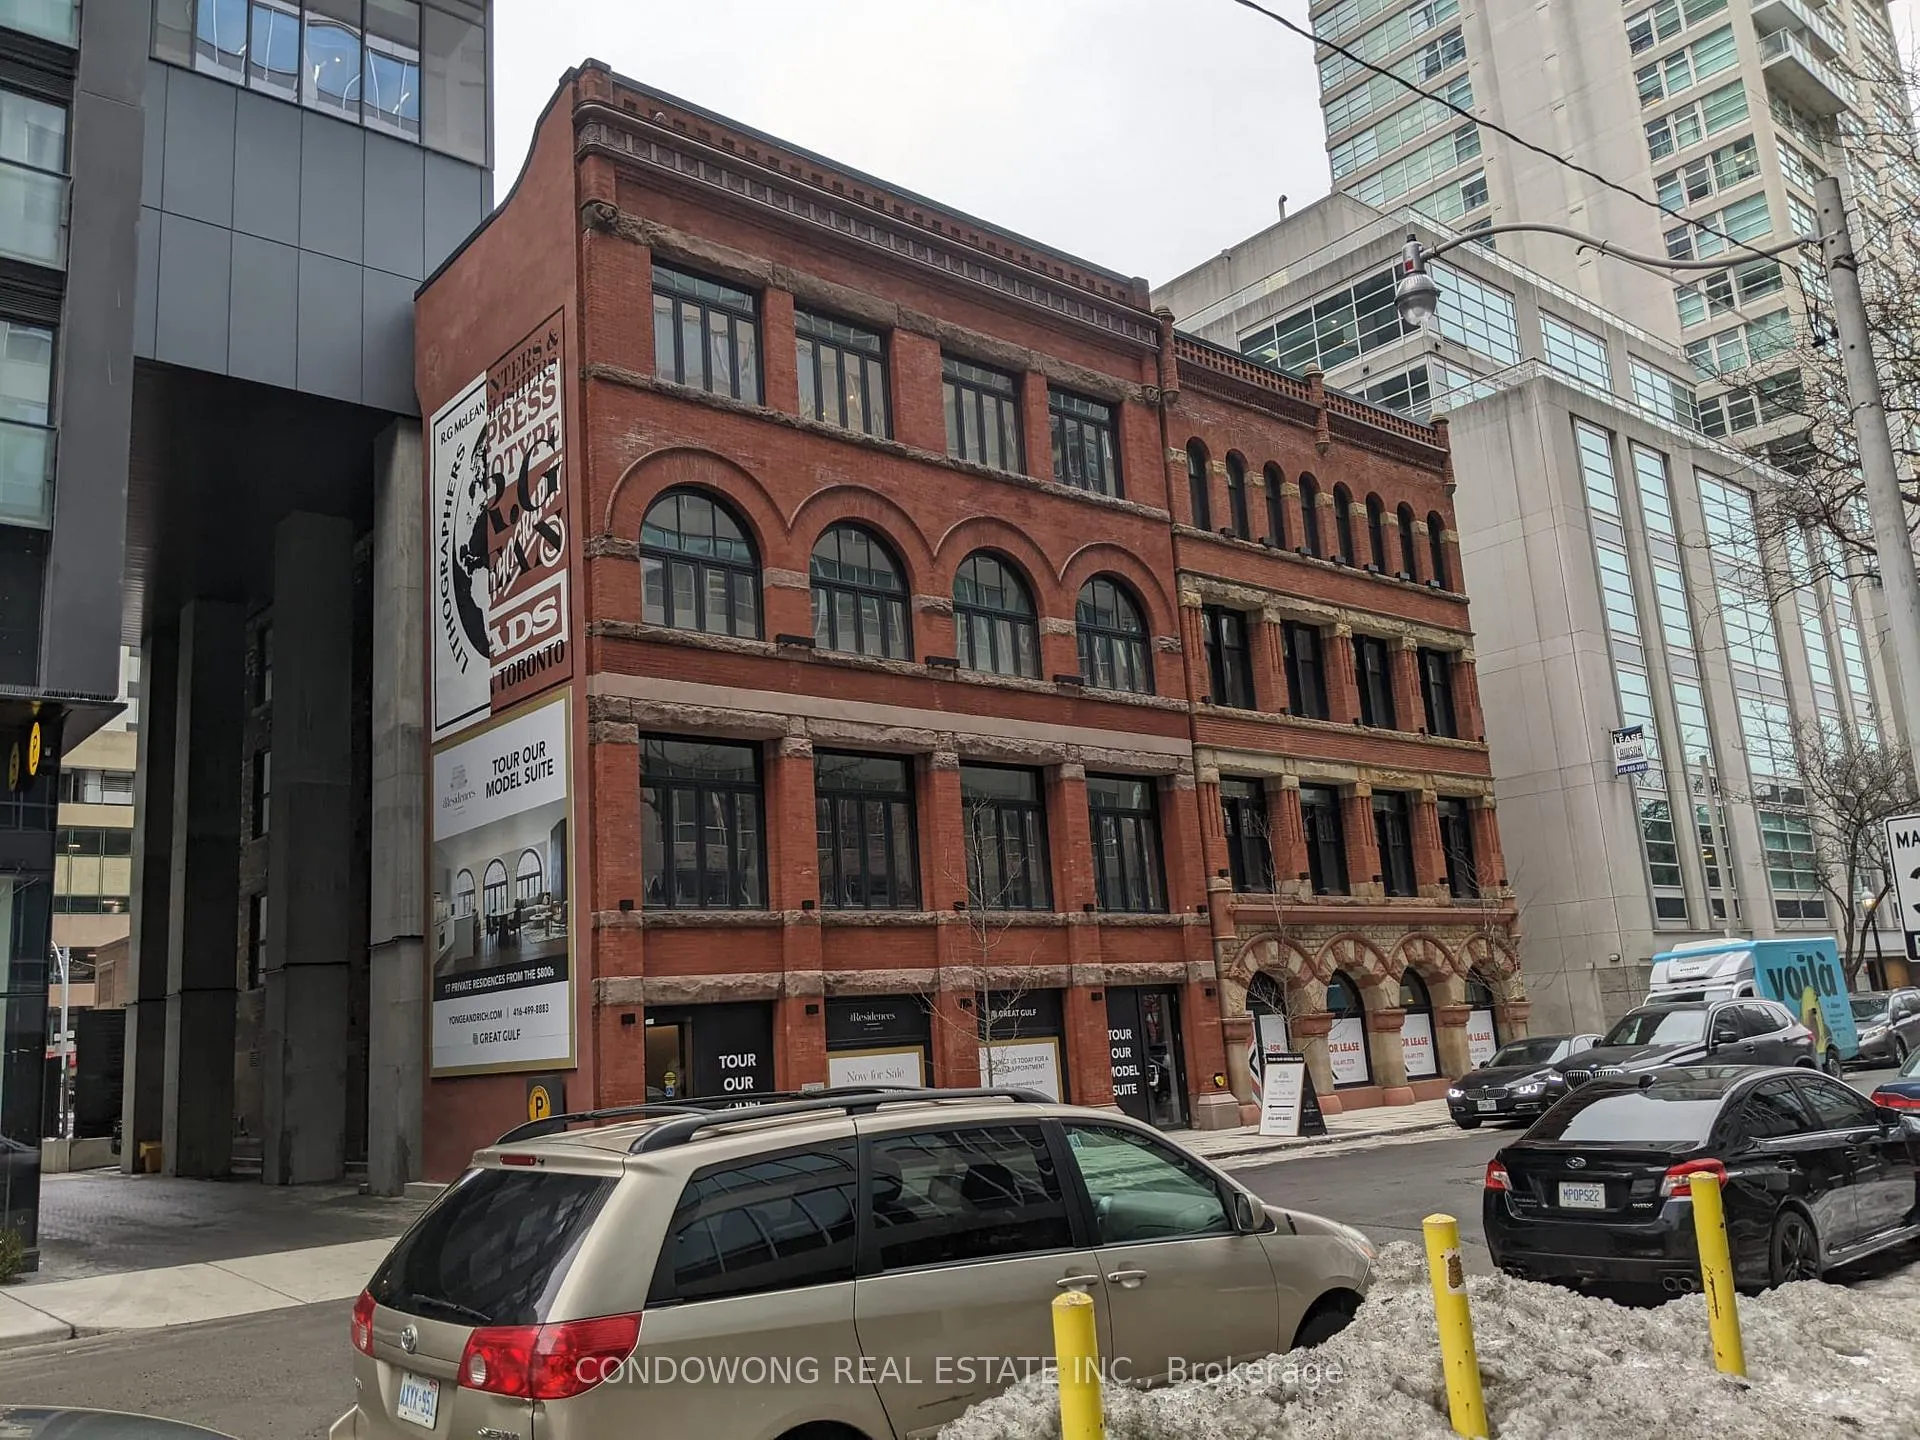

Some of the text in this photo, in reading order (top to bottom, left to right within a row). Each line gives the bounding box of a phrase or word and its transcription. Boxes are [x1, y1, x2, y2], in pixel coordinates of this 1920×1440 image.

[547, 328, 559, 351] &
[487, 373, 557, 454] PRESS
[487, 411, 560, 488] OTYPE
[440, 442, 469, 675] LITHOGRAPHERS
[499, 639, 565, 691] TORONTO
[492, 741, 546, 776] TOUR OUR
[486, 758, 554, 799] MODEL SUITE
[451, 980, 472, 992] PRIVATE
[473, 974, 505, 989] RESIDENCES
[506, 971, 523, 984] FROM
[524, 969, 536, 980] THE
[1767, 951, 1838, 1001] voilà
[998, 1008, 1037, 1018] GREAT GULF
[480, 1028, 521, 1044] GREAT GULF
[1107, 1028, 1133, 1041] TOUR
[1401, 1036, 1429, 1047] OR LEASE
[1473, 1031, 1491, 1042] LEASE
[1111, 1046, 1132, 1059] OUR
[1328, 1041, 1360, 1053] OR LEASE
[719, 1053, 757, 1069] TOUR
[847, 1066, 906, 1083] Now for Sale
[723, 1076, 754, 1091] OUR
[1112, 1083, 1138, 1096] SUITE
[535, 1096, 544, 1118] P
